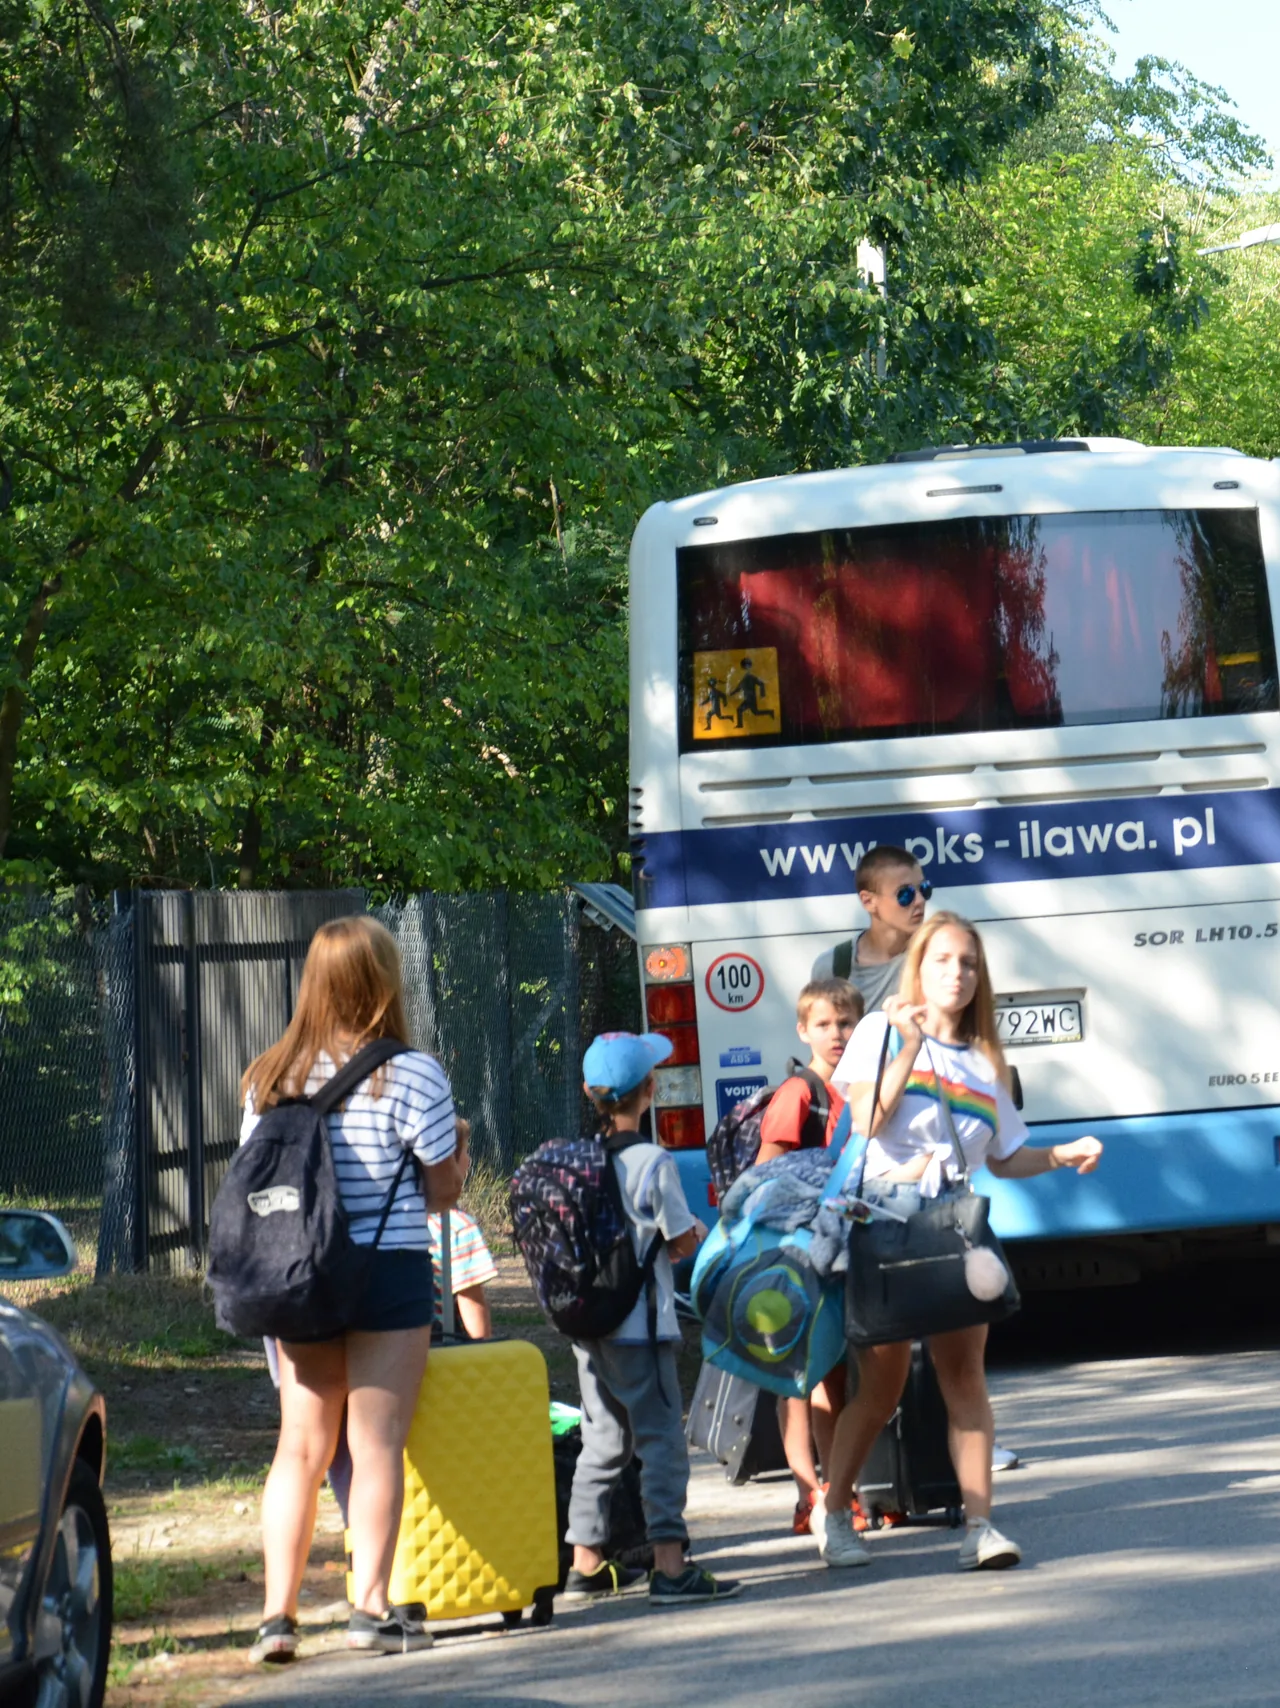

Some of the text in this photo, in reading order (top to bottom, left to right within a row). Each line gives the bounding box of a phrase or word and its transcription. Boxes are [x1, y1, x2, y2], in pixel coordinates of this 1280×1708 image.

[1133, 922, 1279, 948] SOR LH10.5
[717, 963, 751, 990] 100
[728, 992, 744, 1004] km
[1208, 1073, 1247, 1087] EURO
[1250, 1072, 1261, 1085] 5
